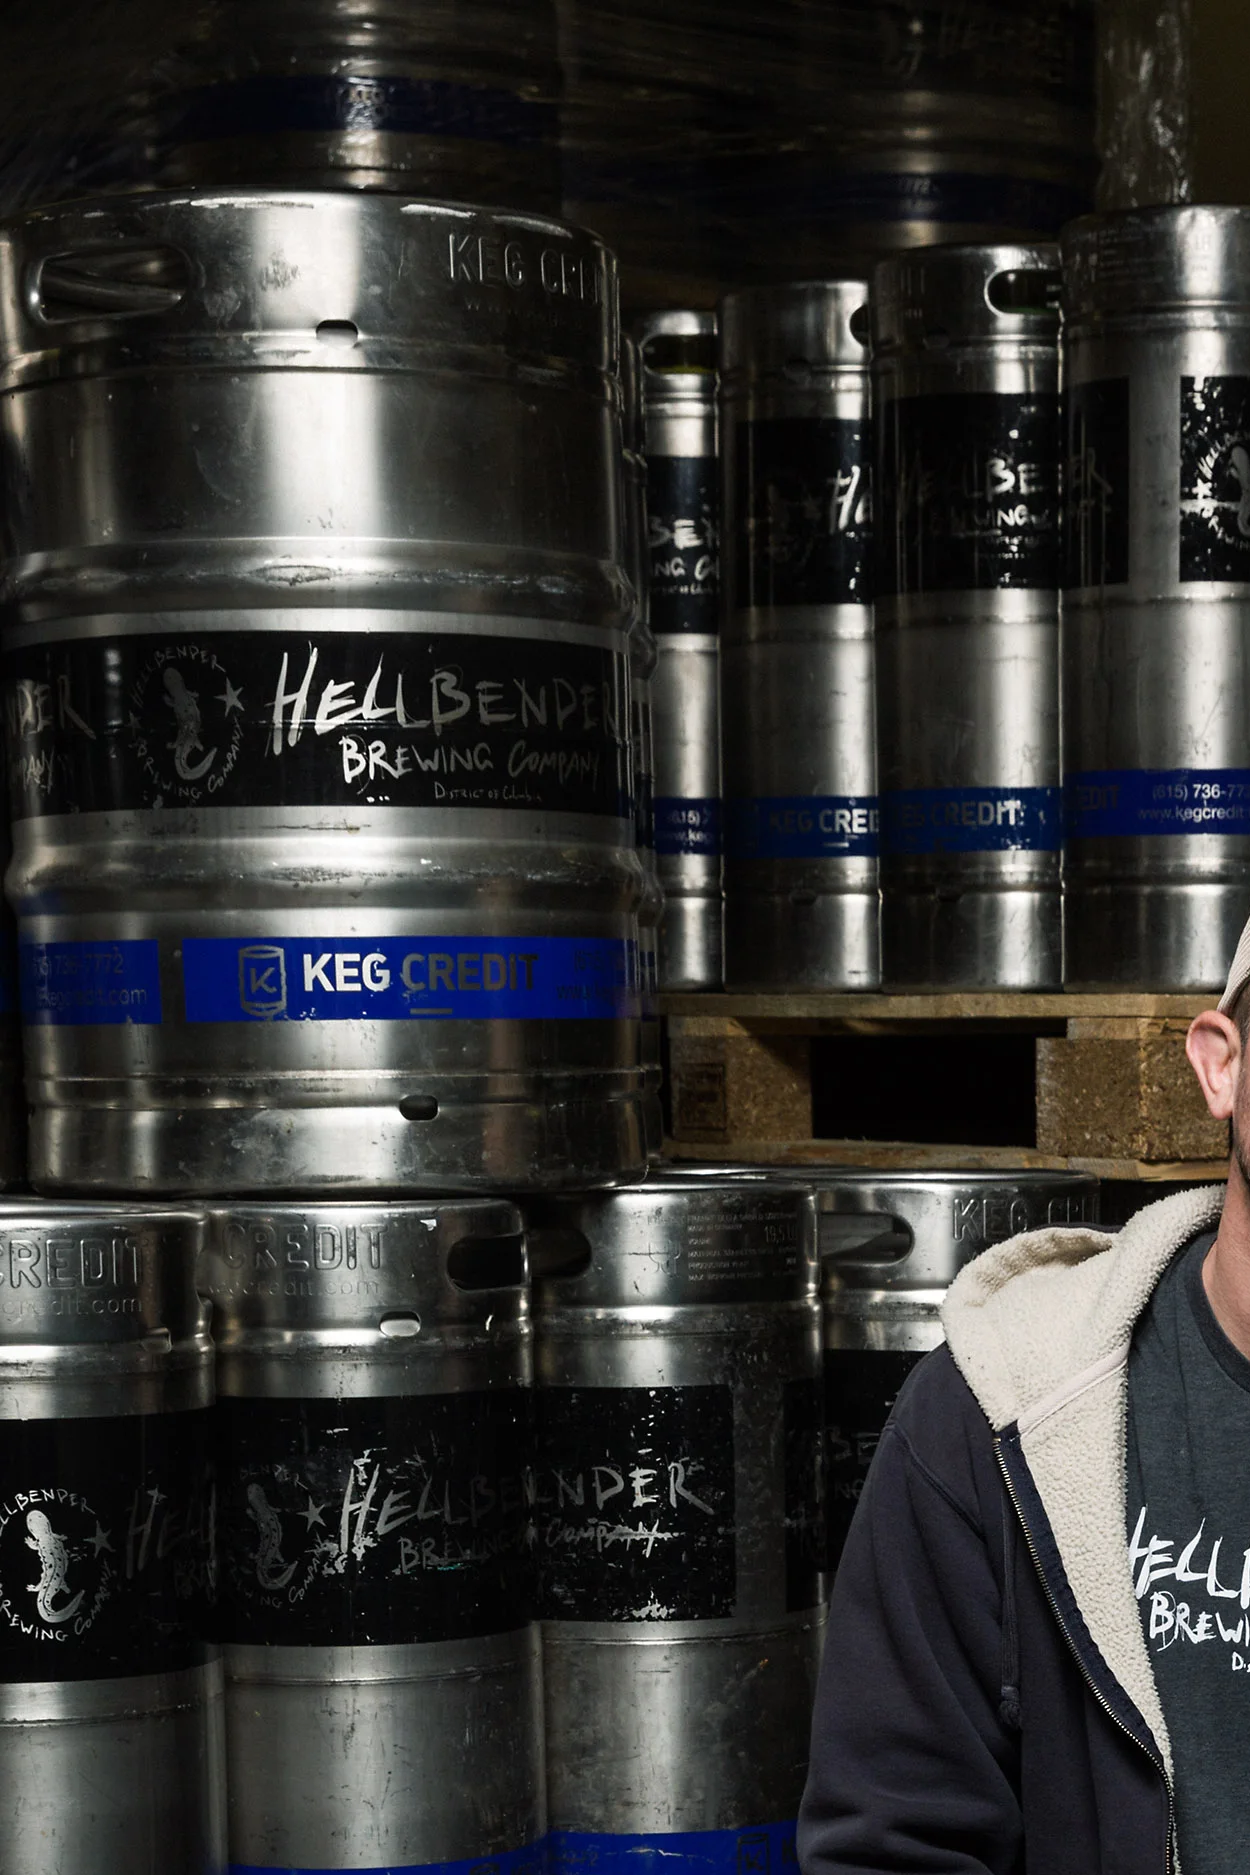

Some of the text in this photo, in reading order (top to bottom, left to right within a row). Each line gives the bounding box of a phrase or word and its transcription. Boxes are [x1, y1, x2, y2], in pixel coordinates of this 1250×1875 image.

[338, 733, 600, 794] BREWING COMPANY
[303, 952, 392, 993] KEG
[402, 952, 539, 992] CREDIT
[954, 1196, 1031, 1240] KEG
[0, 1238, 144, 1289] REDIT
[222, 1222, 388, 1272] CREDIT
[0, 1584, 69, 1643] REWING
